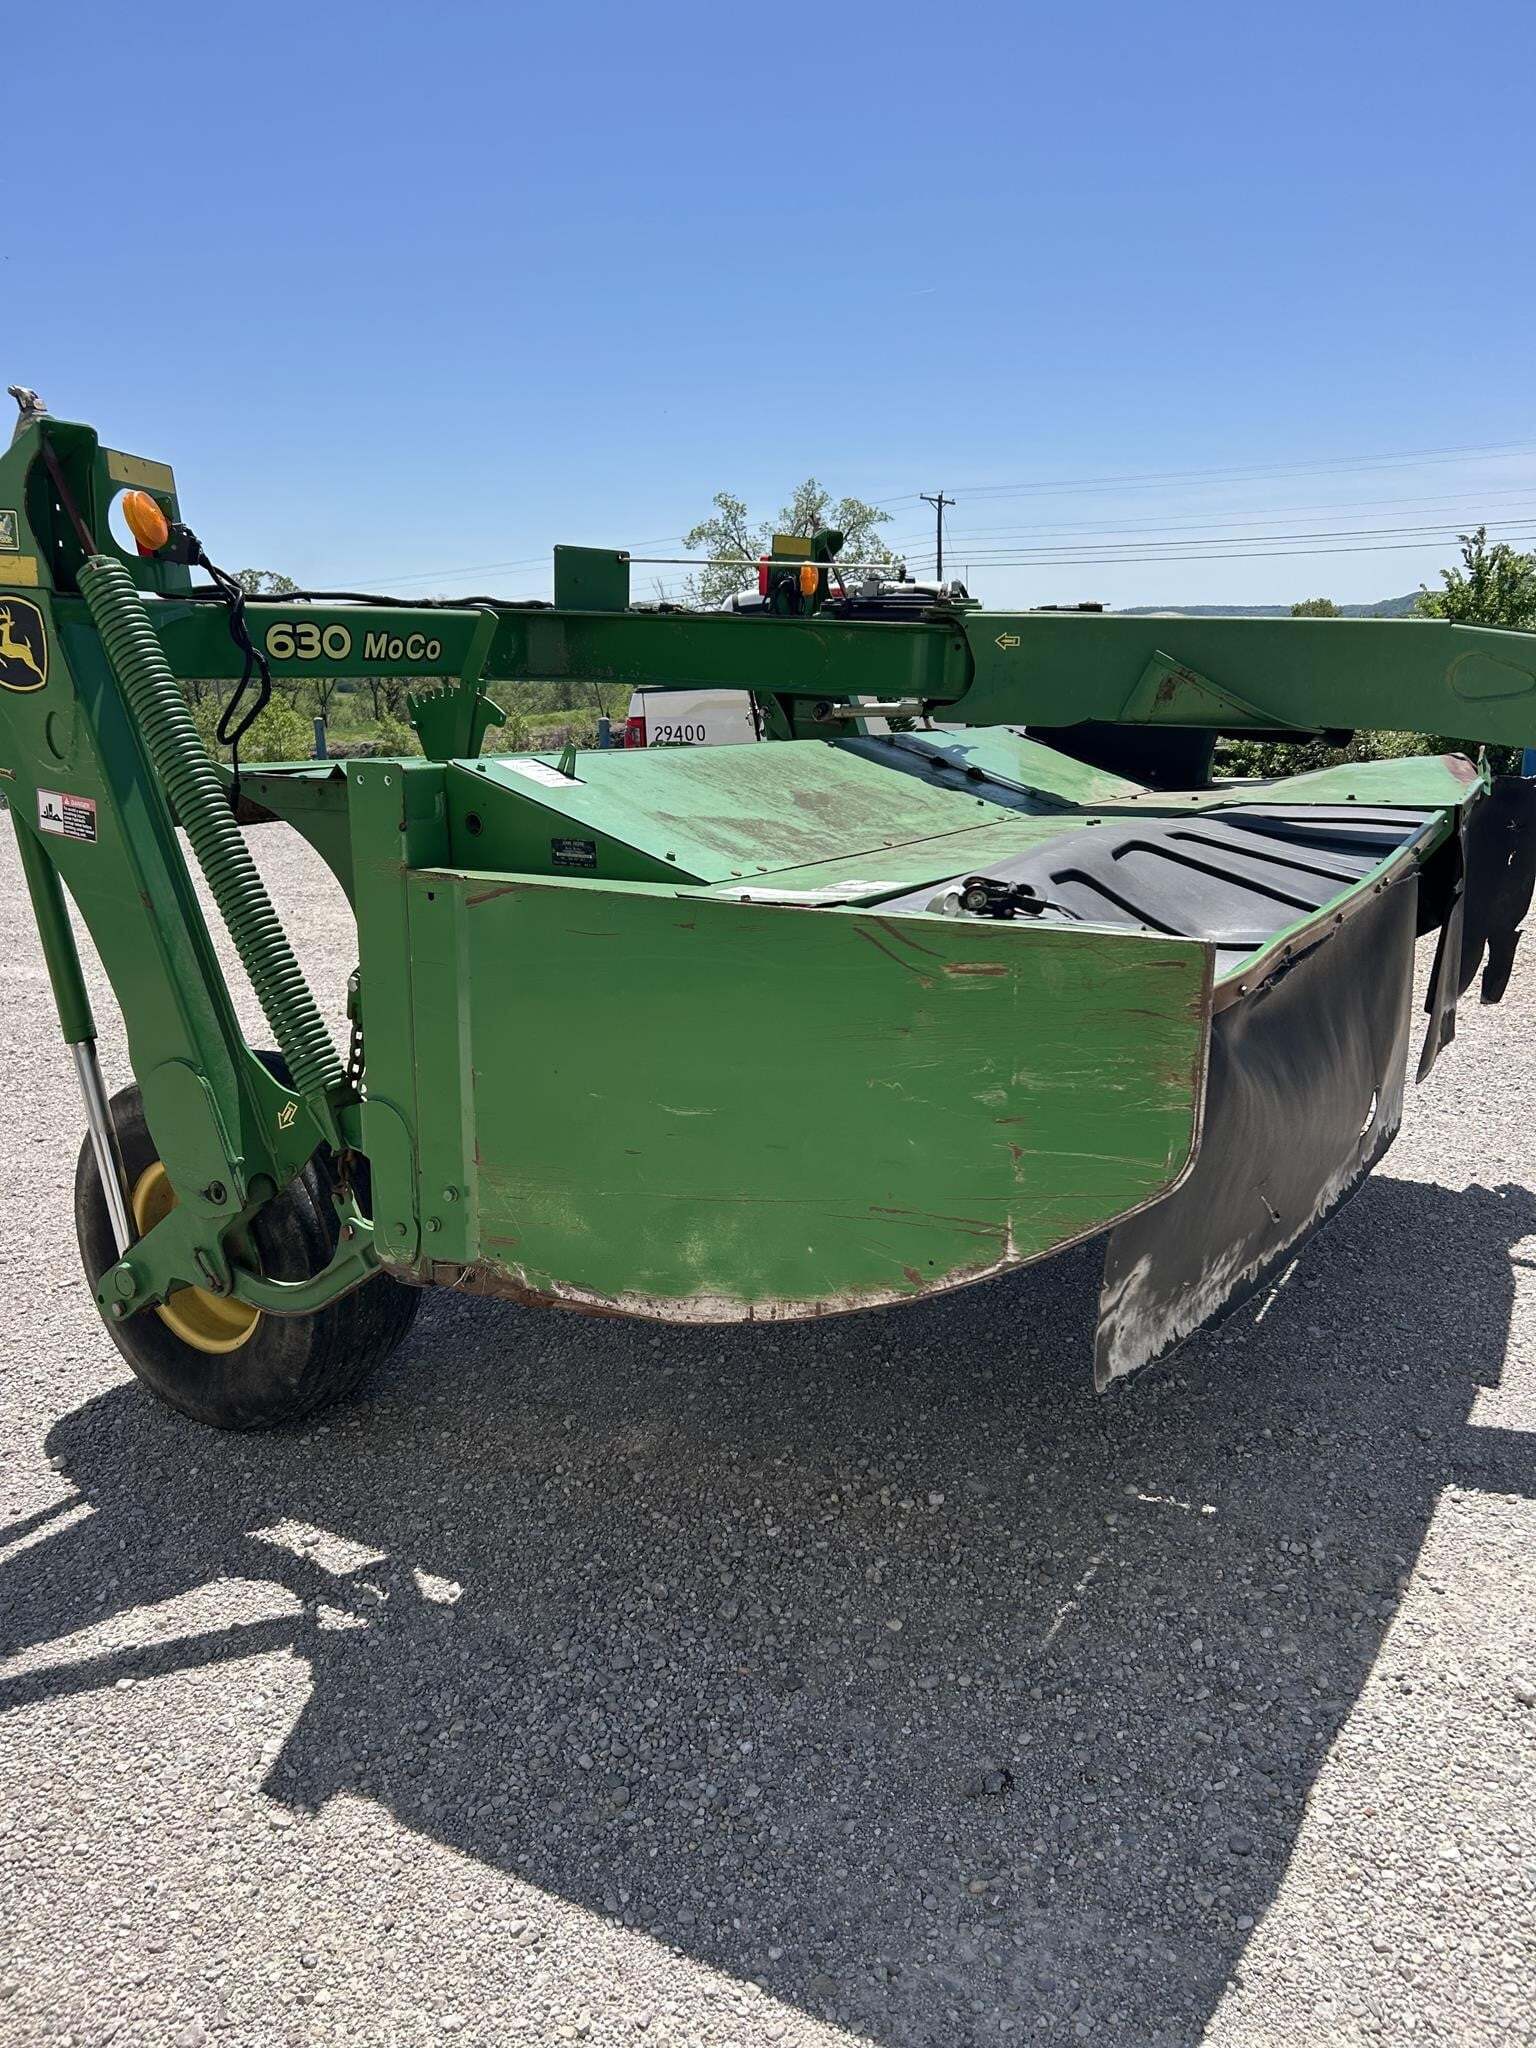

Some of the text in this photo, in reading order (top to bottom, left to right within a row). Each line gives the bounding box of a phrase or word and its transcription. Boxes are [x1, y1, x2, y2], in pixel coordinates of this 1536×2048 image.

[266, 623, 441, 660] 630 MoCo
[655, 724, 705, 741] 29400
